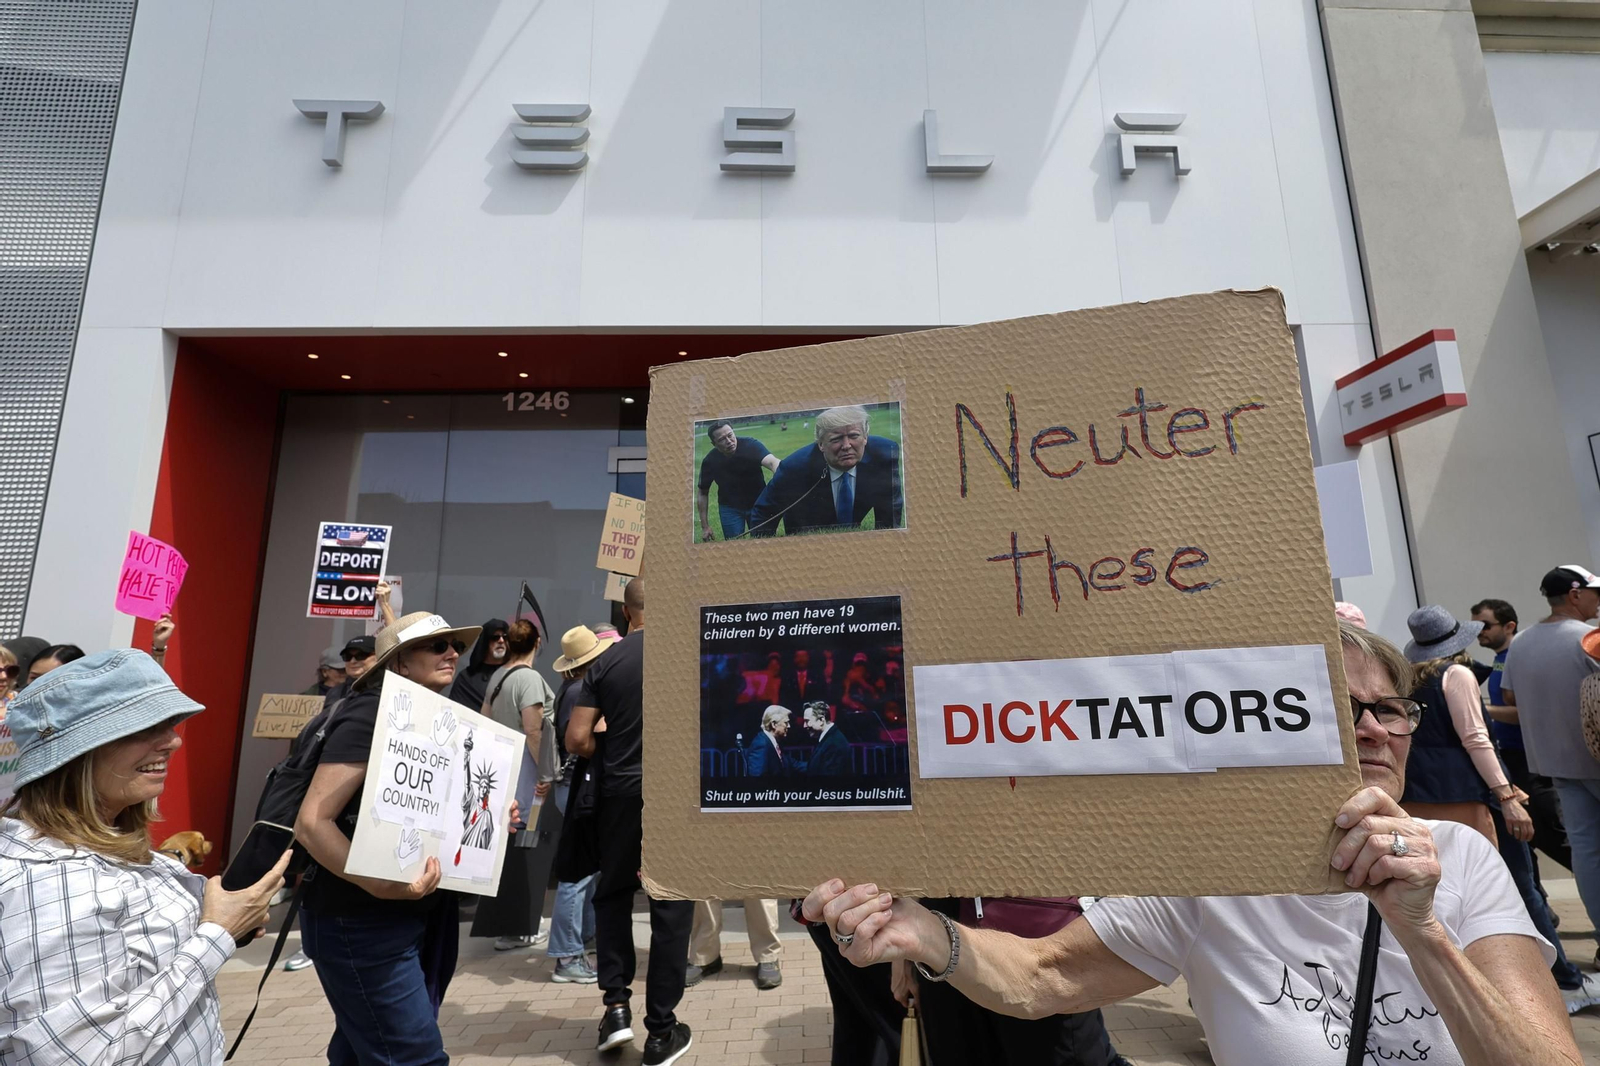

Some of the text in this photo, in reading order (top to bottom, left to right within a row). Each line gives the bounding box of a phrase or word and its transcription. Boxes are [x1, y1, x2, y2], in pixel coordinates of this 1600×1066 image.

[293, 99, 1192, 180] TESLA
[1343, 363, 1434, 416] TESLA
[502, 391, 570, 411] 1246
[955, 385, 1266, 499] Neuter
[615, 497, 632, 509] IF
[611, 517, 625, 529] NO
[612, 531, 640, 546] THEY
[128, 535, 166, 568] HOT
[320, 551, 381, 569] DEPORT
[602, 543, 635, 560] TRY TO
[119, 567, 164, 599] HATE
[986, 531, 1226, 617] these
[316, 584, 376, 602] ELON
[705, 604, 855, 624] These two men have 19
[704, 621, 901, 640] children by 8 different women.
[263, 697, 325, 716] MUSKRA
[943, 687, 1311, 745] DICKTATORS
[256, 719, 287, 733] Lives
[387, 738, 450, 771] HANDS OFF
[394, 762, 433, 794] OUR
[382, 787, 440, 816] COUNTRY!
[705, 787, 906, 803] Shut up with your Jesus bullshit.
